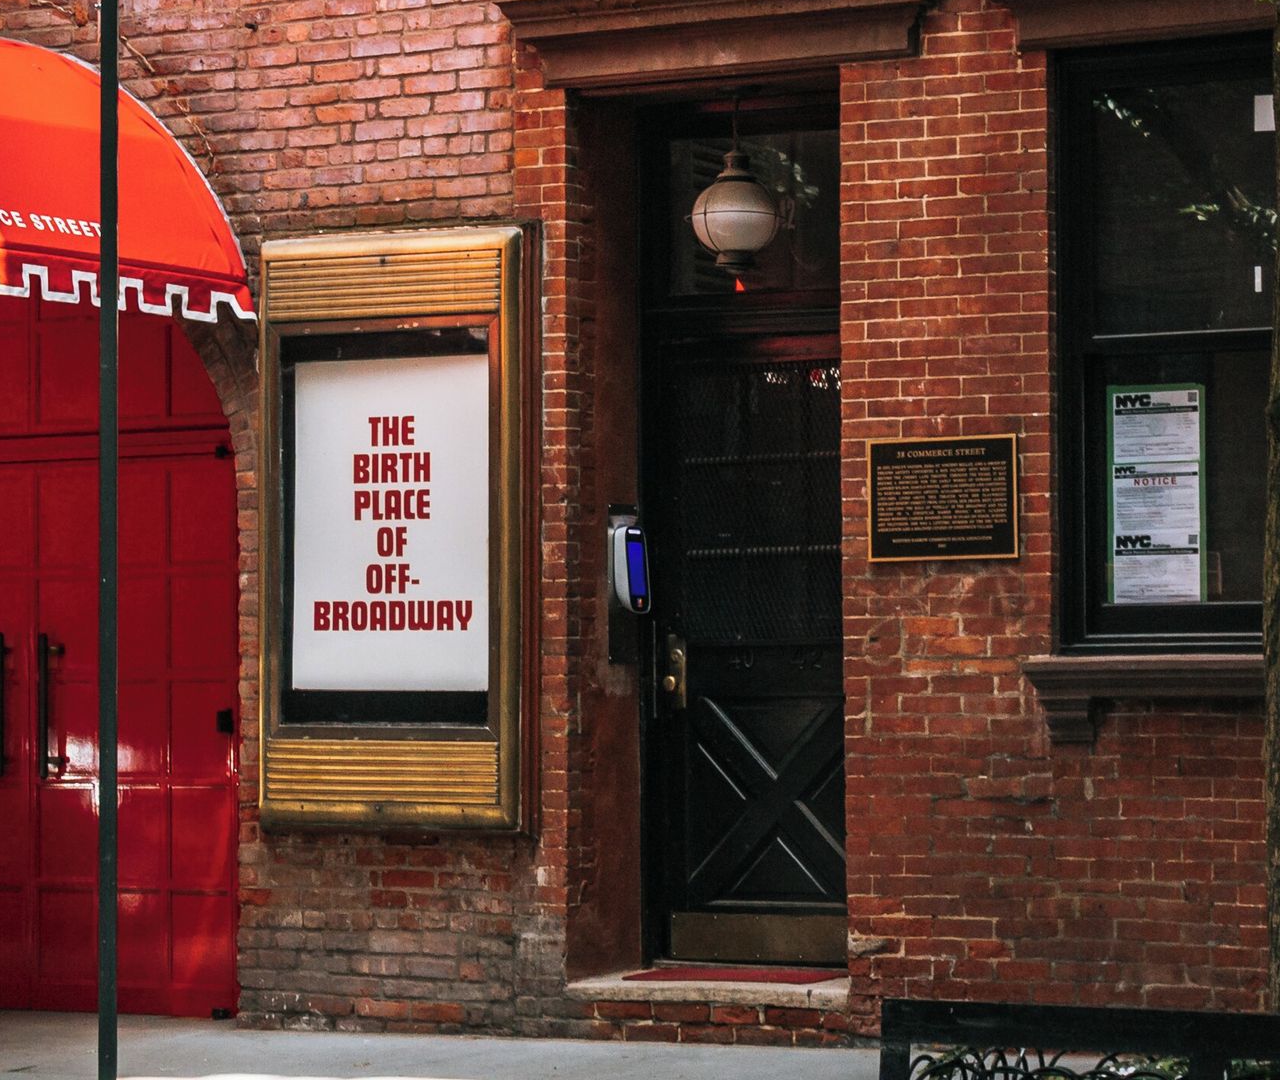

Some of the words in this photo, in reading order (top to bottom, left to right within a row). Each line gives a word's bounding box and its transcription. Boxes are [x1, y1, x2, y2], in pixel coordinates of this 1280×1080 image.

[1115, 393, 1152, 409] NYC
[368, 415, 415, 446] THE
[353, 452, 431, 484] BIRTH
[907, 448, 953, 458] COMMERCE
[955, 447, 986, 457] STREET
[1133, 476, 1177, 487] NOTICE
[353, 489, 431, 521] PLACE
[376, 526, 408, 557] OF
[1116, 535, 1152, 549] NYC
[365, 563, 420, 594] OFF-
[313, 600, 473, 631] BROADWAY
